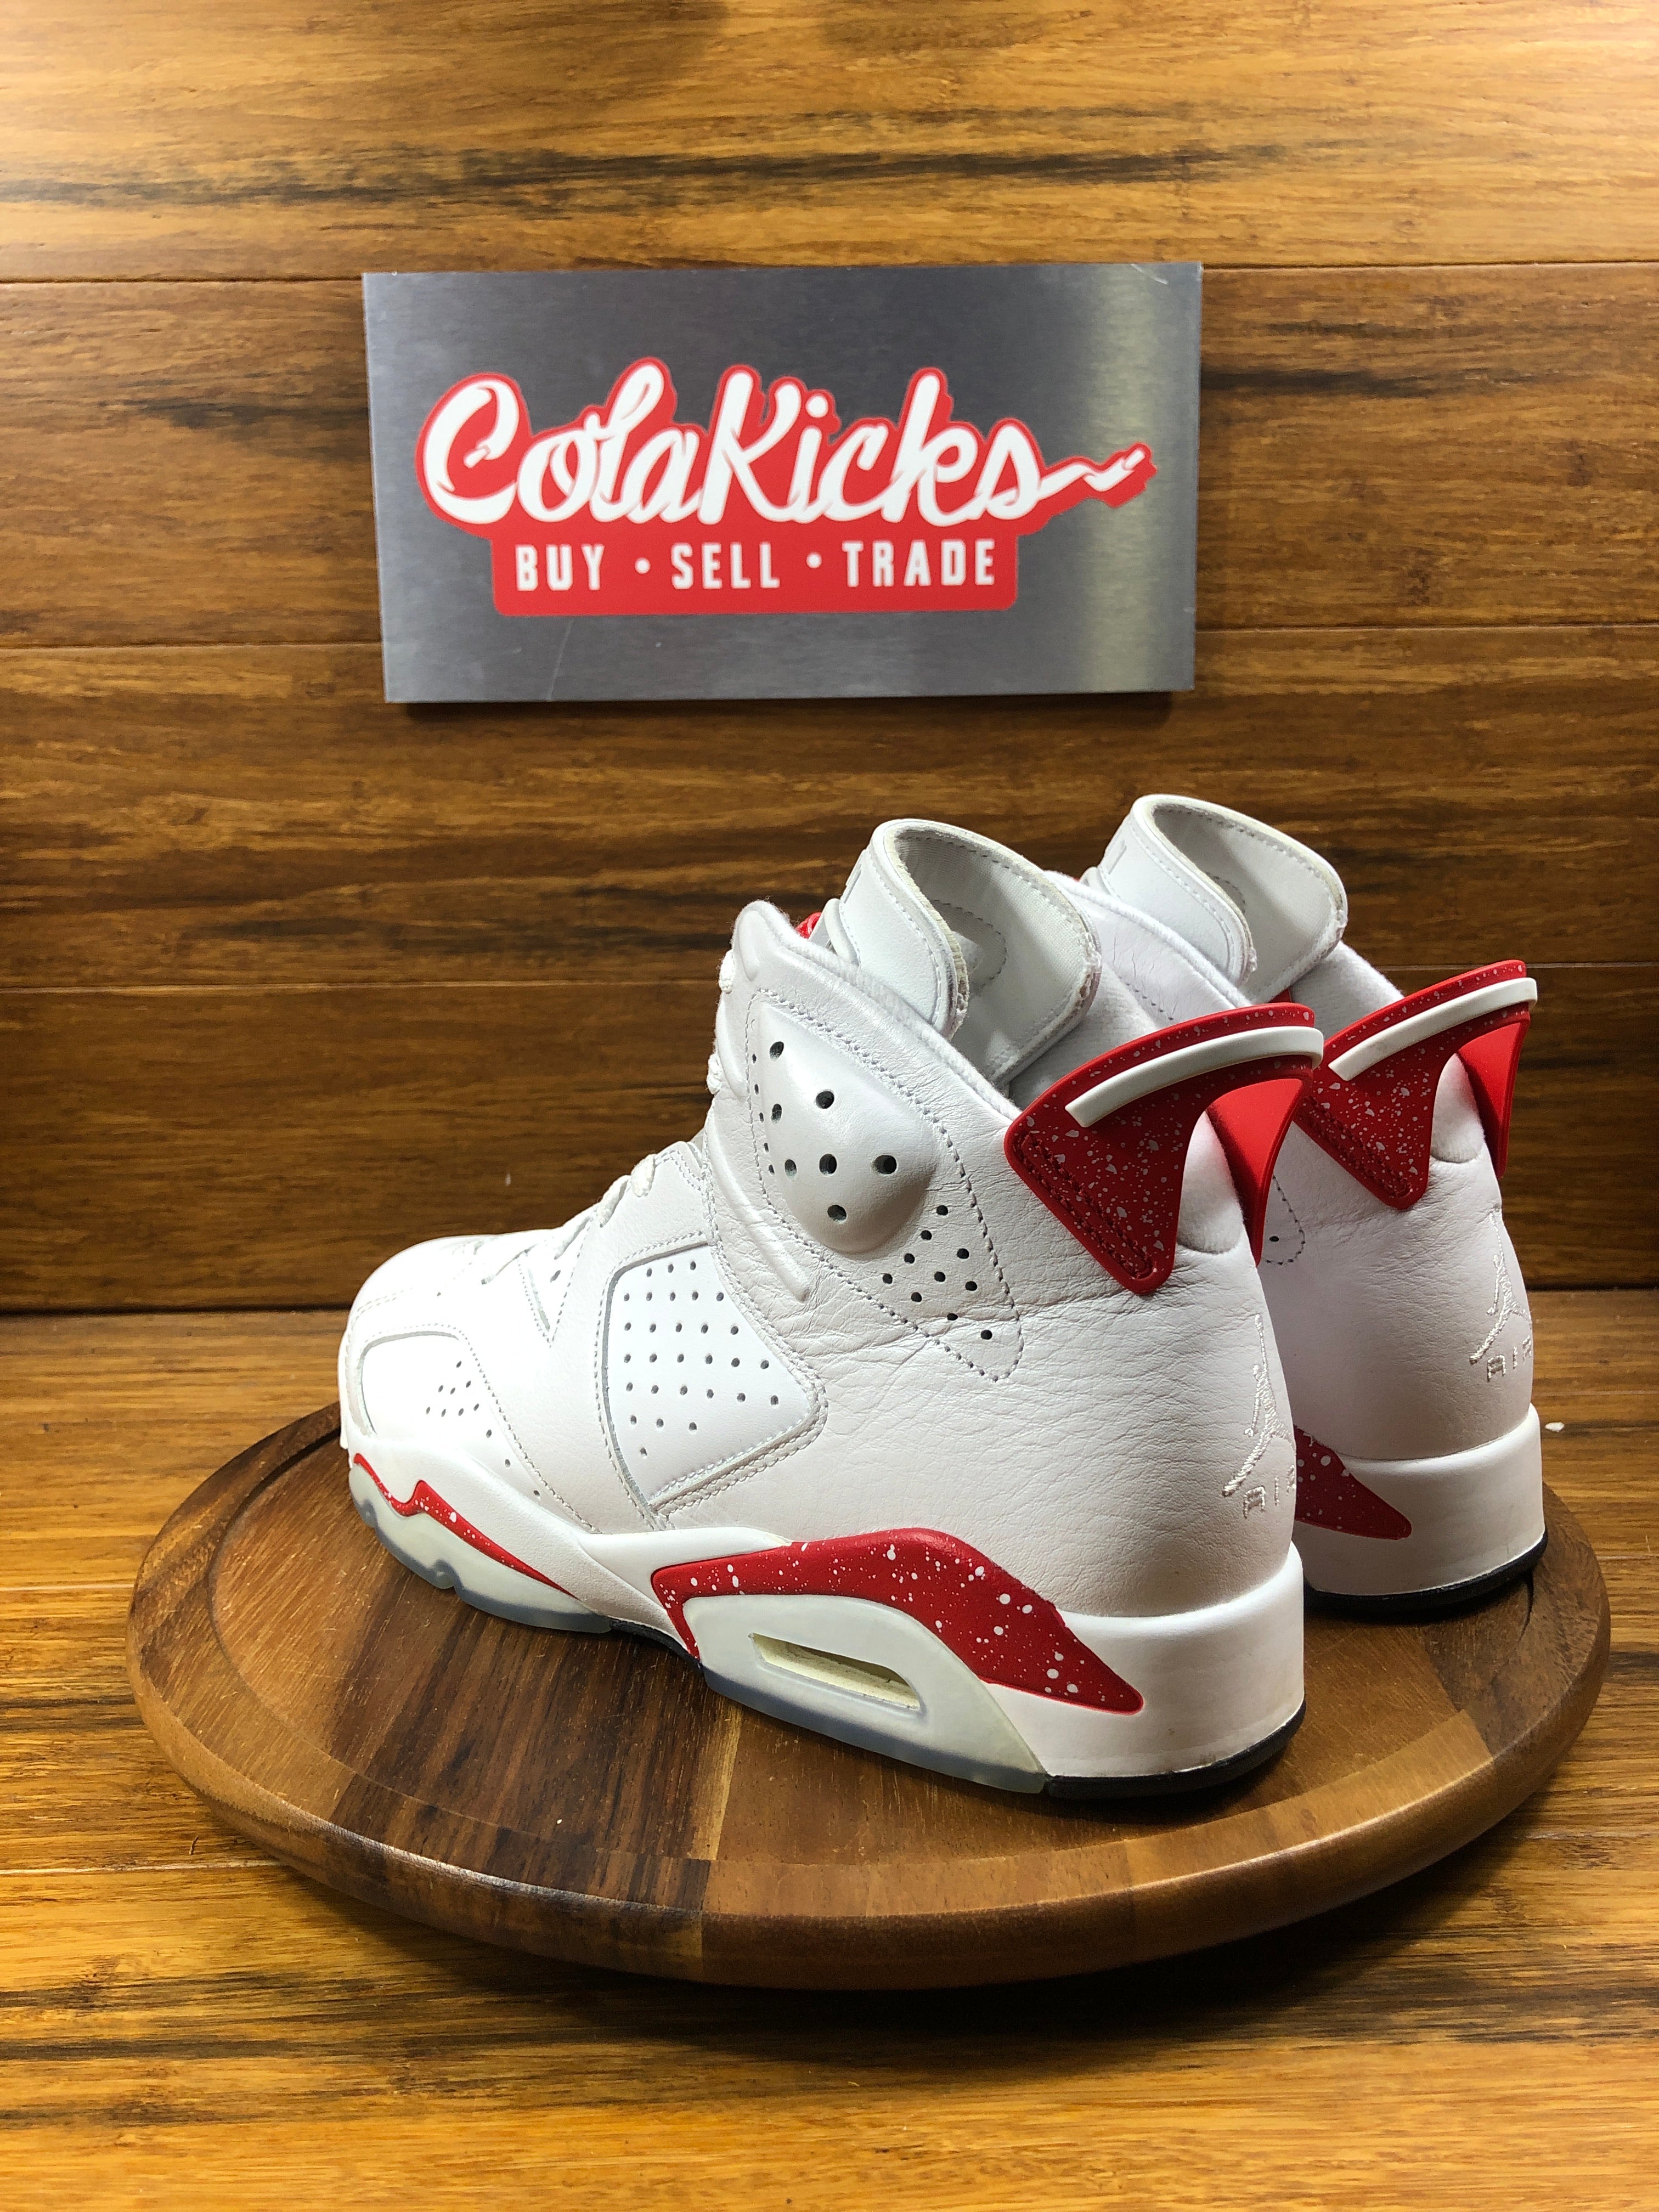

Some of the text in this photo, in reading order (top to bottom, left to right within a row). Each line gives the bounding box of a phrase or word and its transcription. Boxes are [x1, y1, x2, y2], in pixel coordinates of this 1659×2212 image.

[423, 364, 1147, 528] ColaKicks
[516, 540, 994, 590] BUY SELL TRADE
